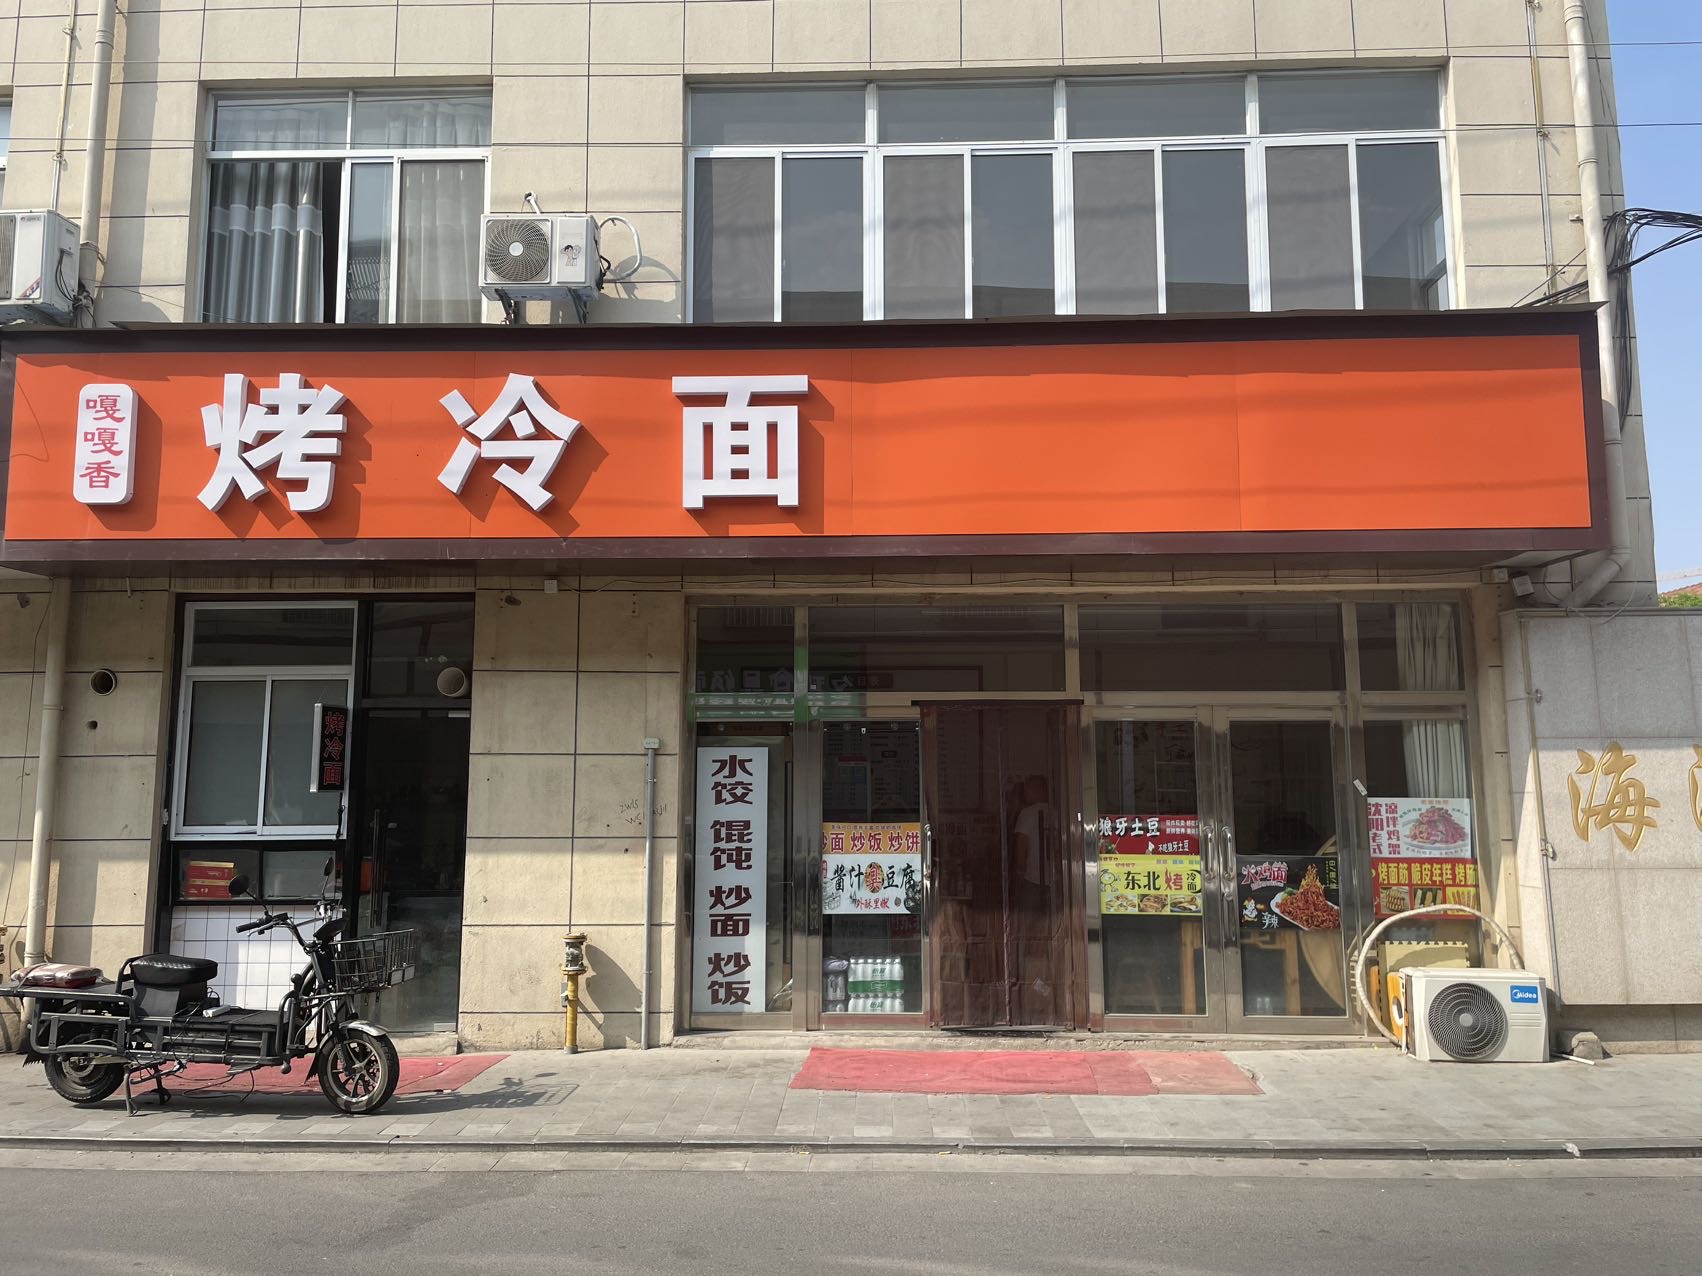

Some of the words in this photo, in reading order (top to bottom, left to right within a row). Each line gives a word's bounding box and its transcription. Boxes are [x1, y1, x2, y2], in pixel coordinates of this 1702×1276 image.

[79, 394, 126, 488] 嘎嘎香
[198, 373, 809, 513] 烤冷面
[323, 711, 345, 785] 烤冷面
[711, 754, 754, 805] 水饺
[1567, 740, 1702, 852] 海
[709, 819, 753, 871] 馄饨
[850, 831, 883, 852] 炒饭
[887, 831, 921, 852] 炒饼
[830, 862, 915, 893] 酱汁臭豆腐
[1241, 861, 1289, 885] 火鸡面
[1378, 862, 1409, 885] 烤面筋
[1411, 862, 1453, 885] 脆皮年糕
[708, 884, 752, 937] 炒面
[1261, 911, 1280, 930] 辣
[707, 951, 751, 1006] 炒饭
[1512, 989, 1537, 999] Midea
